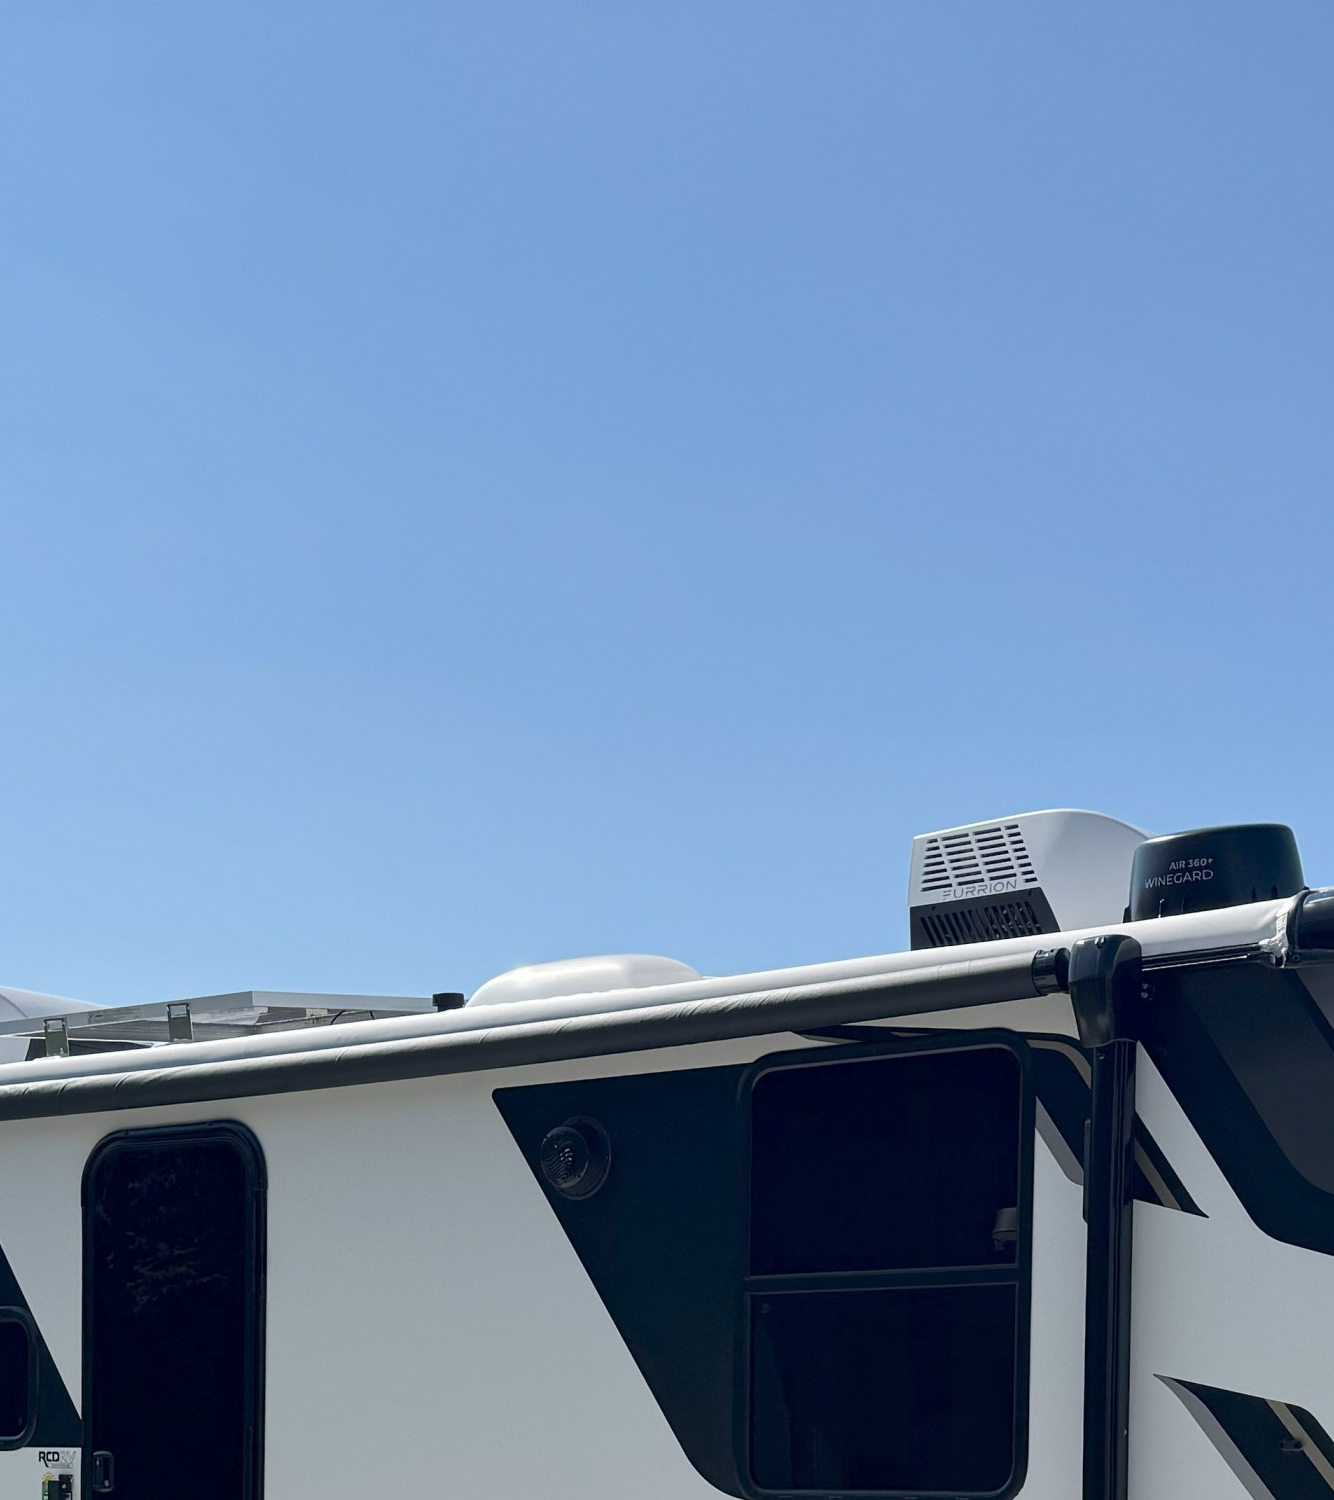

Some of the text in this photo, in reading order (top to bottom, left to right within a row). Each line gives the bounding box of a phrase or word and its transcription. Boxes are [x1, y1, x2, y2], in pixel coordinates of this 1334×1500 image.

[1169, 859, 1186, 871] AIR
[1144, 869, 1214, 889] WINEGARD
[942, 880, 1017, 901] FURRION
